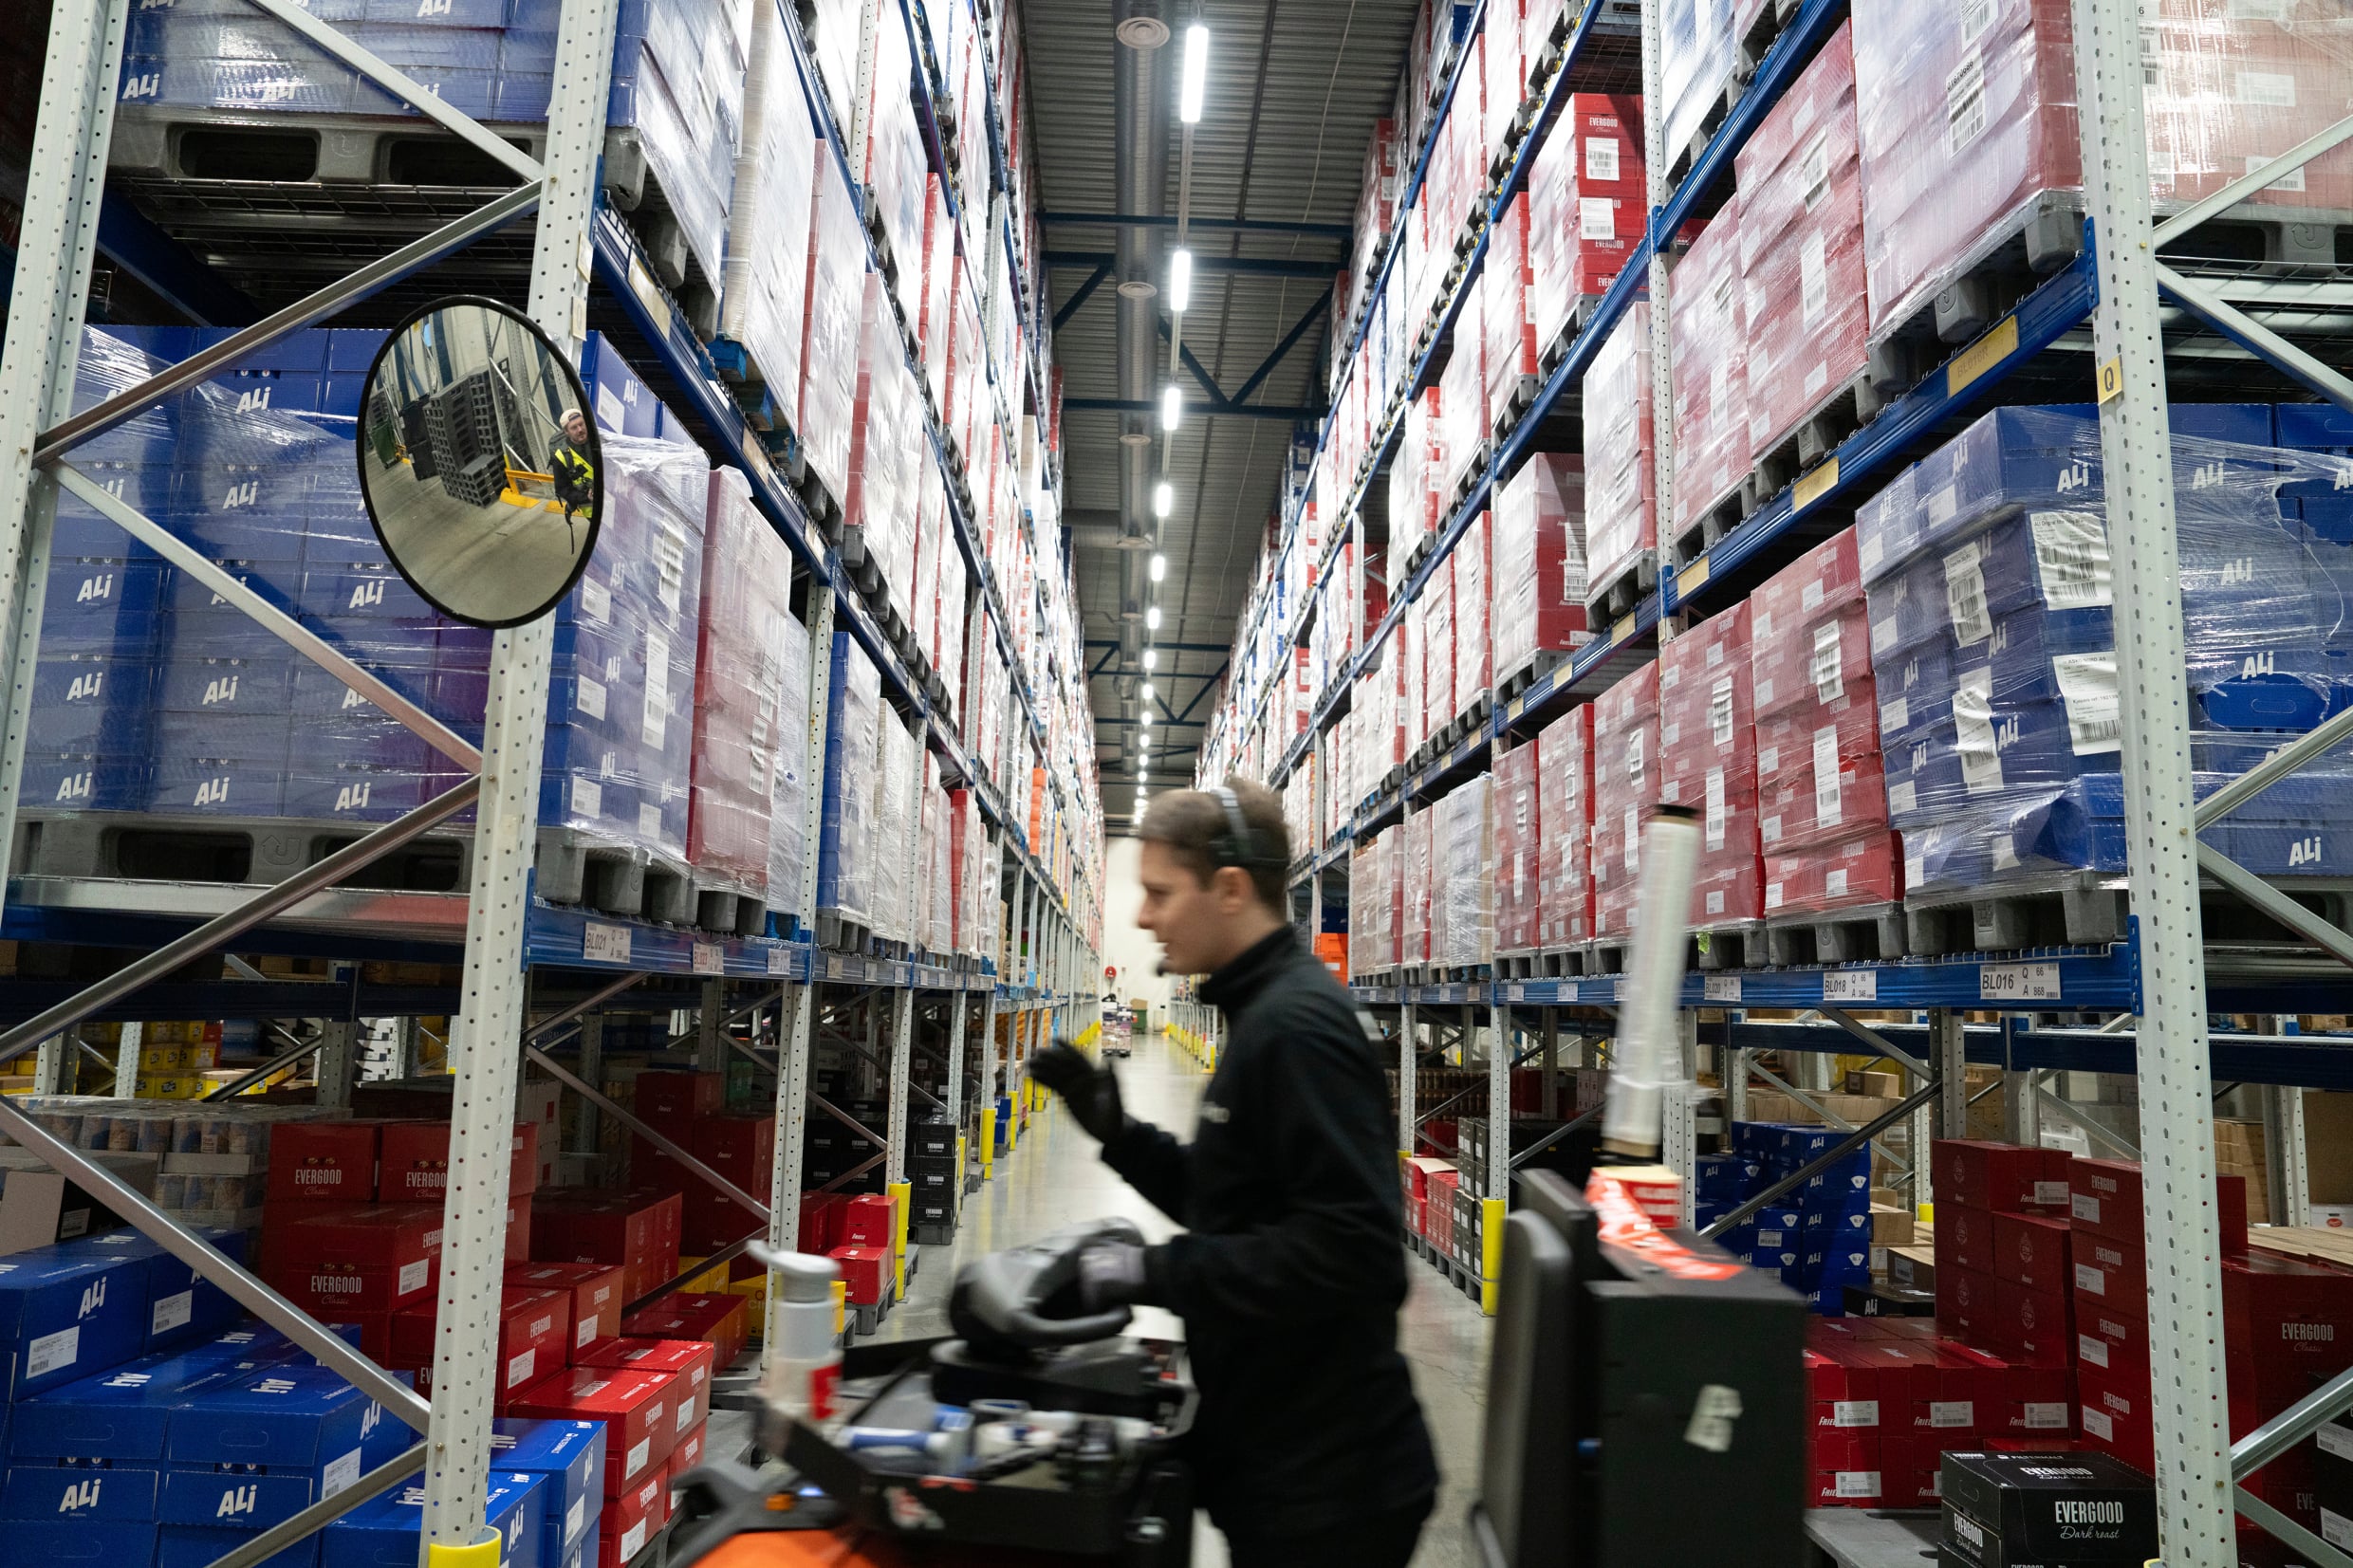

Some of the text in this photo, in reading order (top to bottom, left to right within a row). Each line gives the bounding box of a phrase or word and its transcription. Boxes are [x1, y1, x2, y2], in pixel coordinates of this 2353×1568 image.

[122, 74, 159, 100] ALi
[1589, 118, 1618, 127] EVERGOOD
[623, 379, 639, 406] ALi
[2104, 366, 2114, 392] Q
[236, 386, 271, 414] ALi
[1952, 438, 1968, 477] ALi
[2057, 461, 2089, 492] ALi
[2192, 462, 2224, 490] ALi
[223, 481, 258, 509] ALi
[2220, 557, 2252, 585] ALi
[77, 574, 113, 602] ALi
[349, 580, 385, 608] ALi
[1904, 656, 1918, 691] ALi
[2242, 651, 2274, 679] ALi
[66, 672, 102, 700] ALi
[202, 676, 238, 705] ALi
[1997, 715, 2019, 751] ALi
[1912, 741, 1927, 774] ALi
[56, 771, 92, 801] ALi
[194, 777, 230, 806] ALi
[334, 782, 371, 811] ALi
[2288, 837, 2321, 866] ALi
[1825, 980, 1846, 993] BL018
[1852, 974, 1856, 984] Q
[1982, 974, 2013, 989] BL016
[2022, 968, 2029, 979] Q
[2023, 985, 2029, 996] A
[295, 1169, 342, 1185] EVERGOOD
[406, 1171, 448, 1188] EVERGOO
[1810, 1175, 1824, 1188] ALi
[2091, 1175, 2117, 1193] EVERGOOD
[1808, 1213, 1822, 1226] ALi
[1807, 1252, 1822, 1264] ALi
[2096, 1246, 2122, 1266] EVERGOOD
[78, 1277, 107, 1319] ALi
[311, 1276, 362, 1293] EVERGOOD
[1865, 1299, 1878, 1316] ALi
[530, 1315, 551, 1338] EVERGOOD
[2099, 1318, 2125, 1339] EVERGOOD
[2282, 1322, 2334, 1341] EVERGOOD
[2294, 1342, 2323, 1353] Classic
[645, 1401, 663, 1427] EVERGOOD
[2103, 1391, 2130, 1414] EVERGOOD
[59, 1479, 102, 1512] ALi
[216, 1485, 257, 1518] ALi
[639, 1480, 658, 1507] EVERGOOD
[2055, 1501, 2124, 1523] EVERGOOD
[508, 1503, 524, 1552] ALi
[1954, 1513, 1984, 1548] EVERGOOD
[2060, 1525, 2120, 1539] Dark roast
